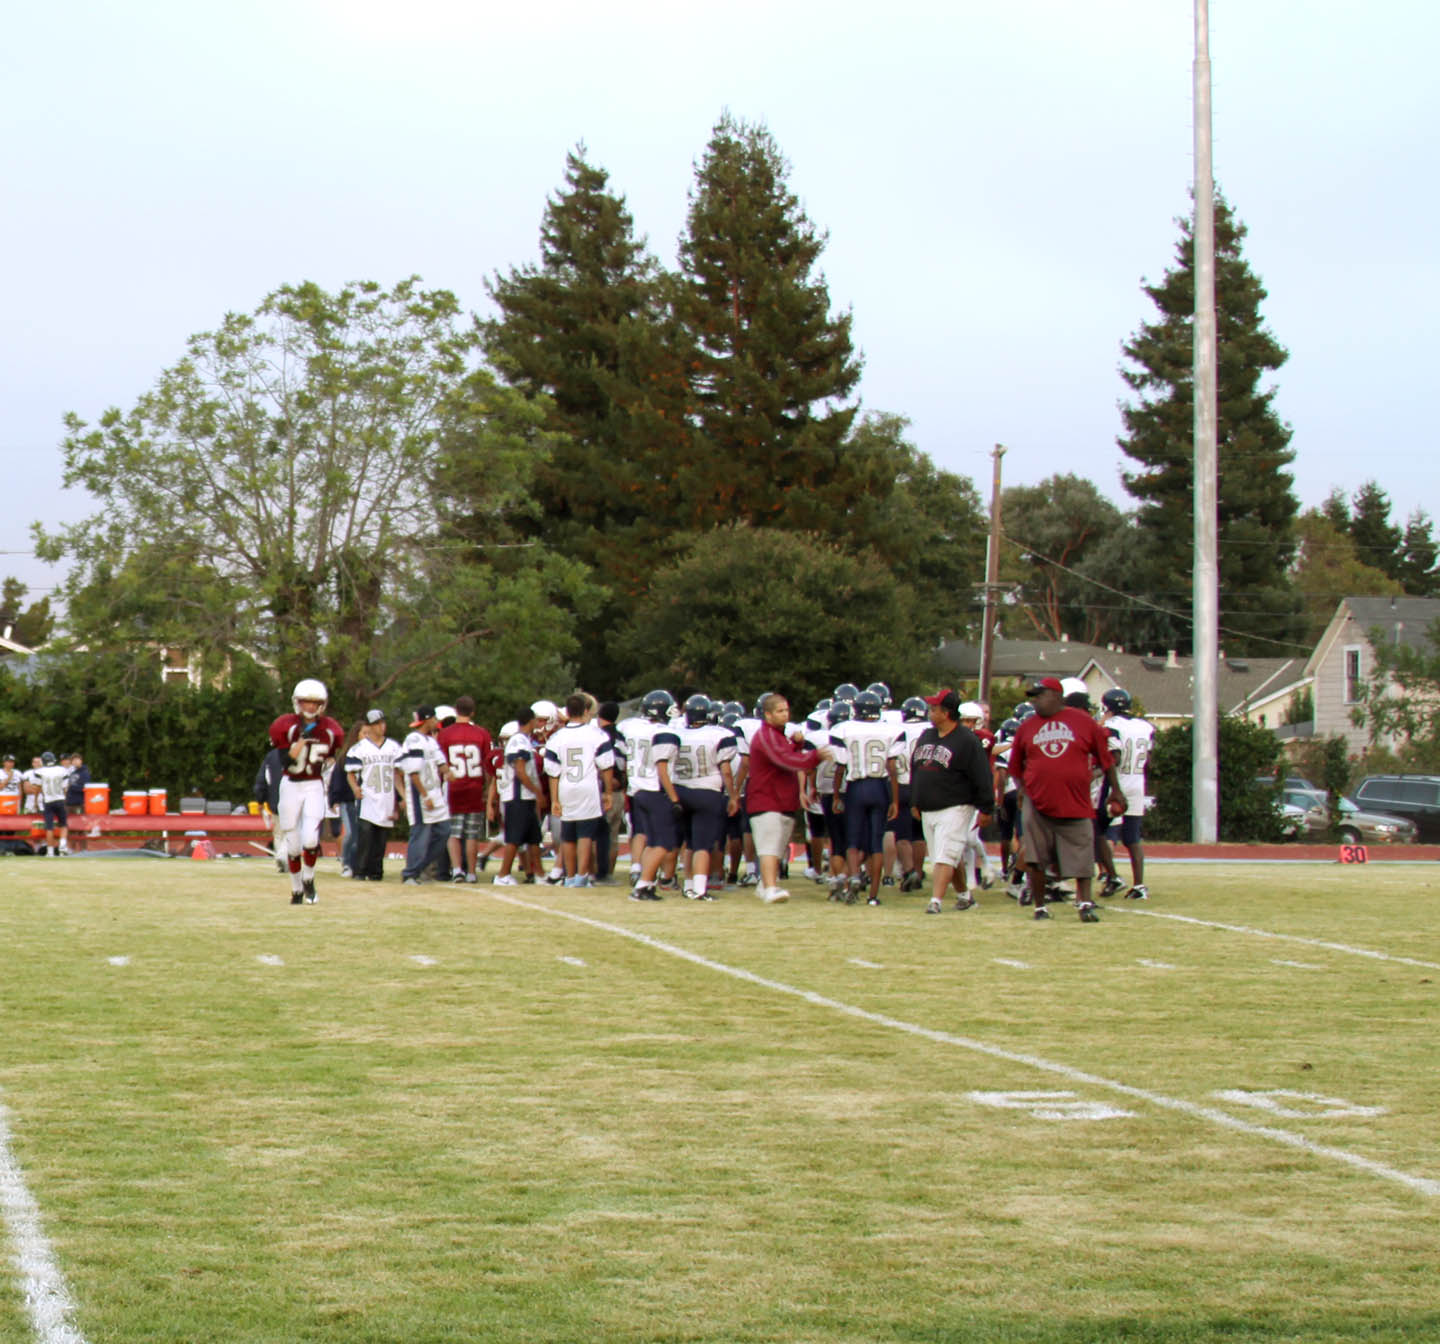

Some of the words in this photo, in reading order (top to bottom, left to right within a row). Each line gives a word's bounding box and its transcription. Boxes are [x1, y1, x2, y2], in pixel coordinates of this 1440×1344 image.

[448, 744, 483, 779] 52
[566, 747, 584, 783] 5
[849, 739, 887, 778] 16
[1120, 737, 1147, 775] 12
[1343, 846, 1366, 863] 30
